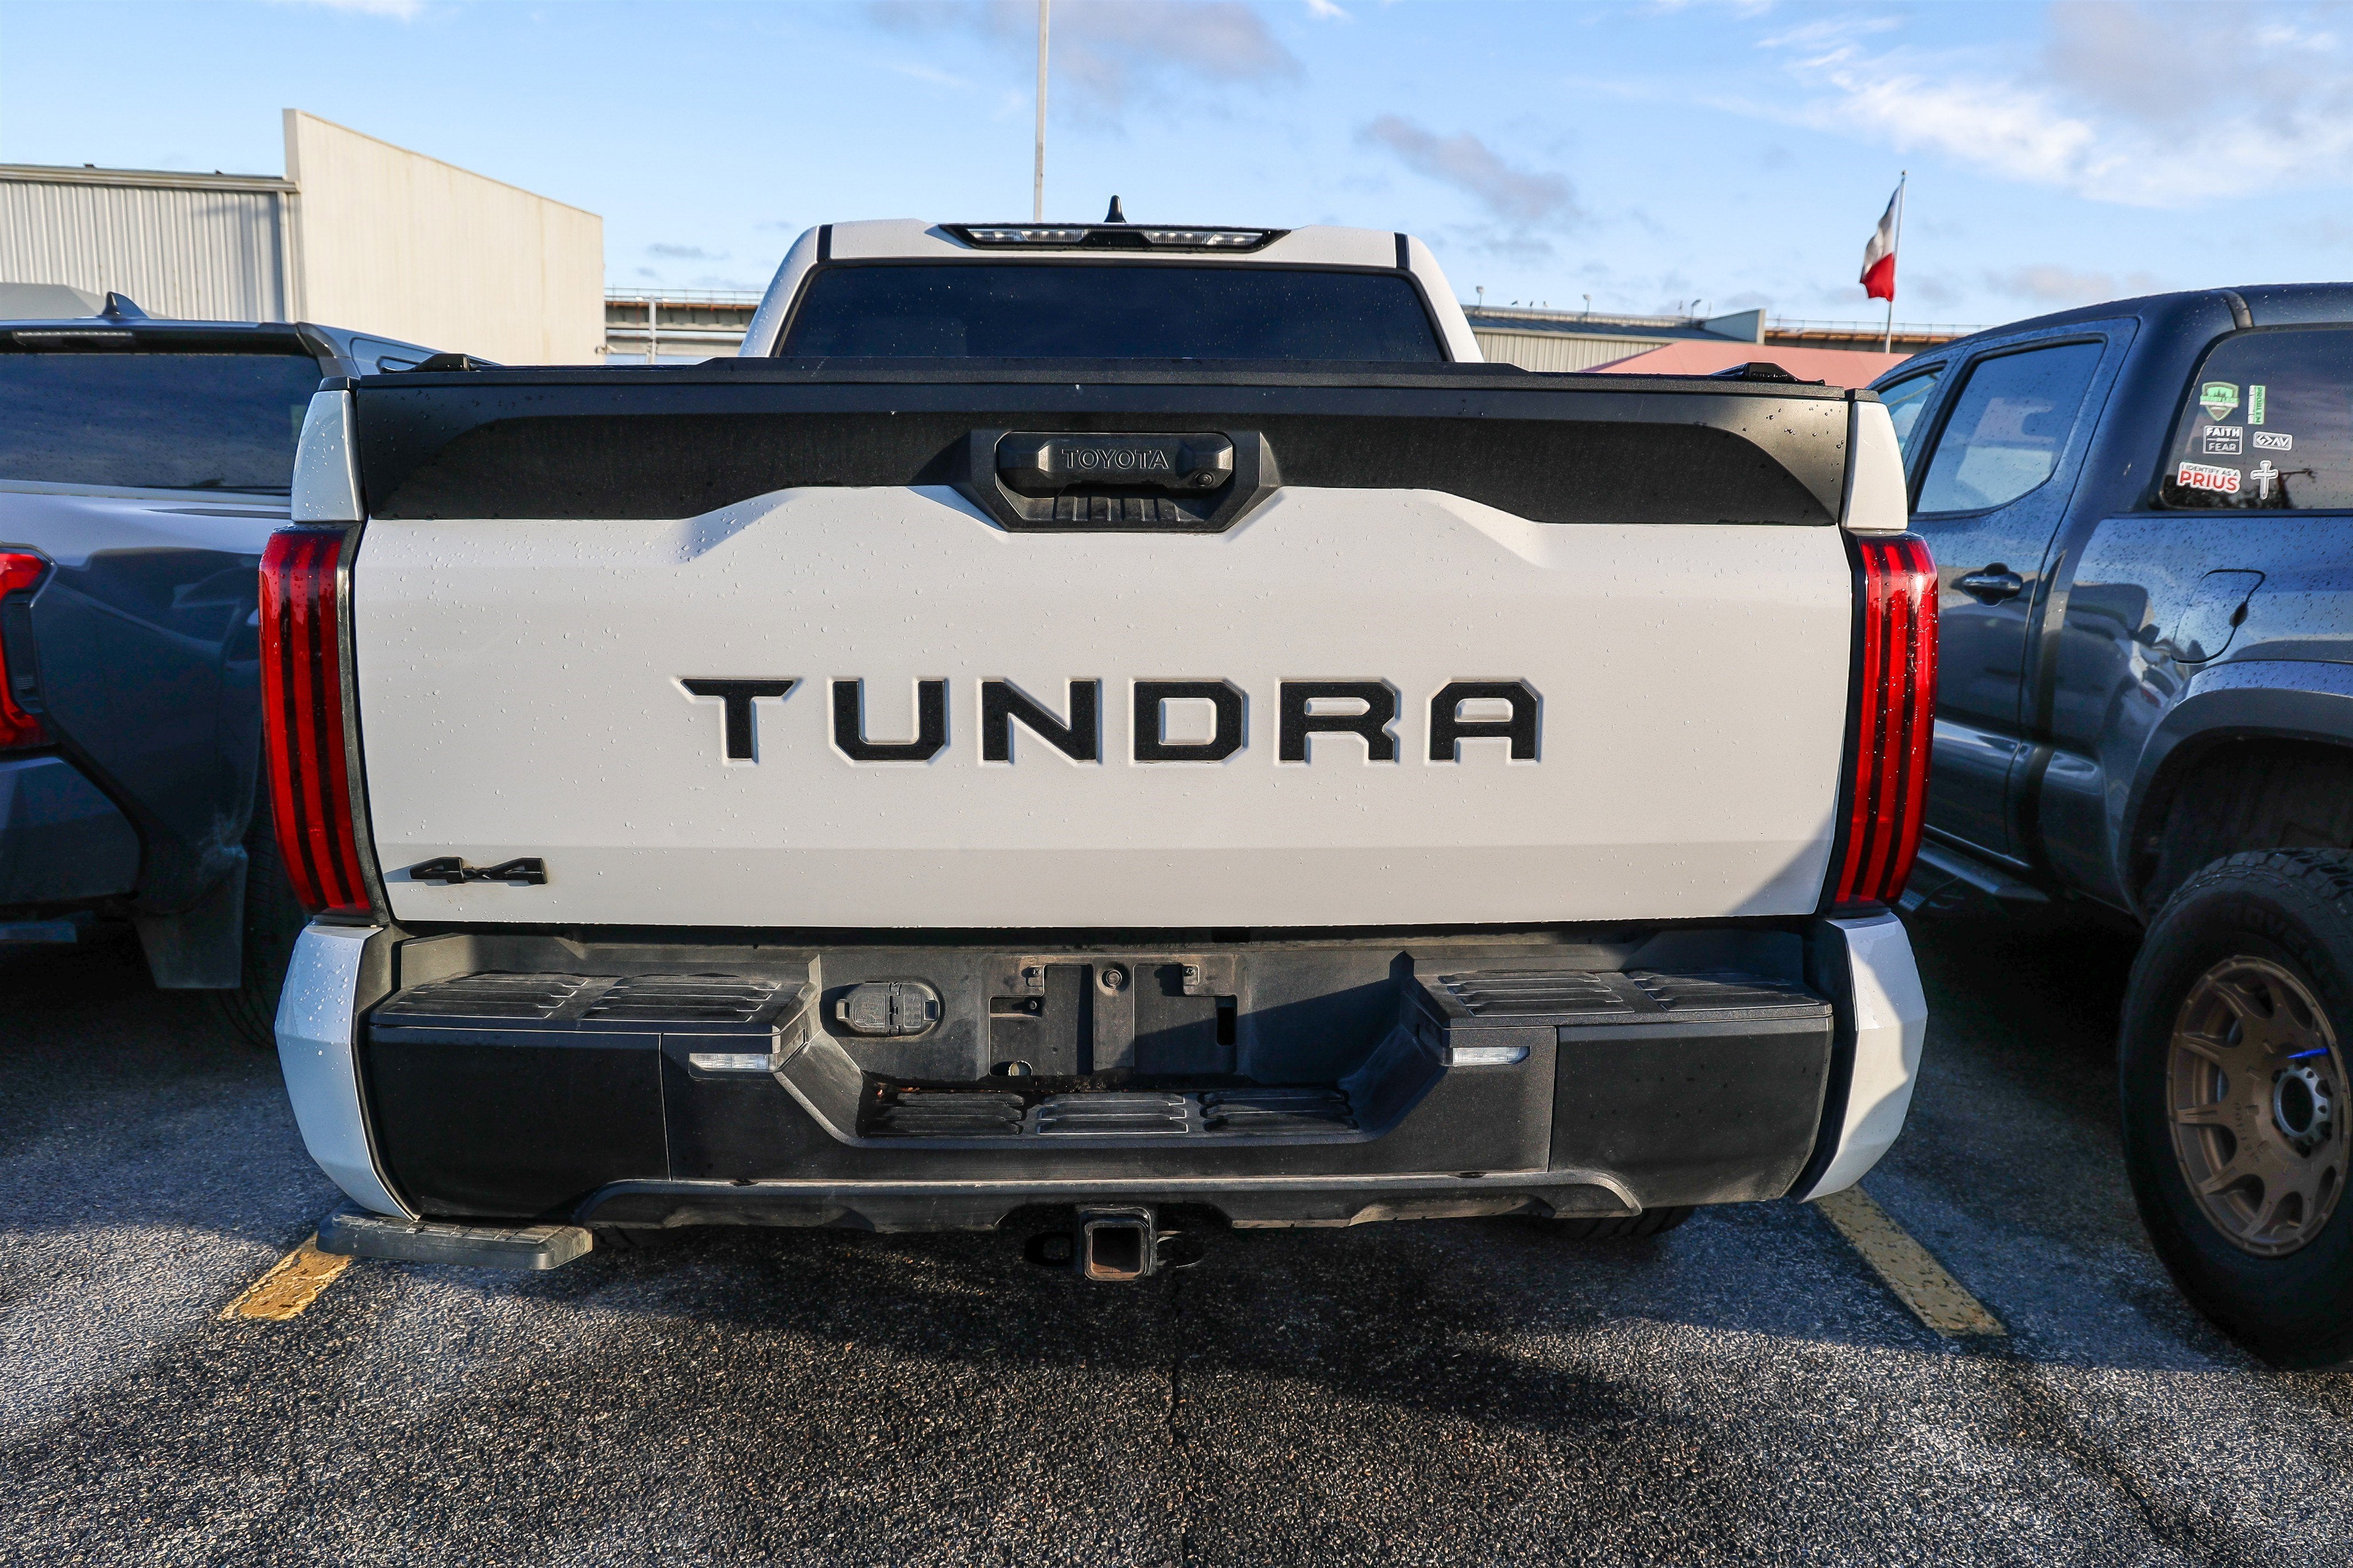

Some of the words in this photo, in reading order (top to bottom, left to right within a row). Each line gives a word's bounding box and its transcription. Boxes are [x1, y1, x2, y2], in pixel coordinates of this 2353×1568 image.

[2206, 427, 2240, 437] FAITH
[2208, 442, 2236, 451] FEAR
[1061, 448, 1170, 470] TOYOTA
[2180, 470, 2237, 491] PRIUS
[679, 678, 1541, 764] TUNDRA
